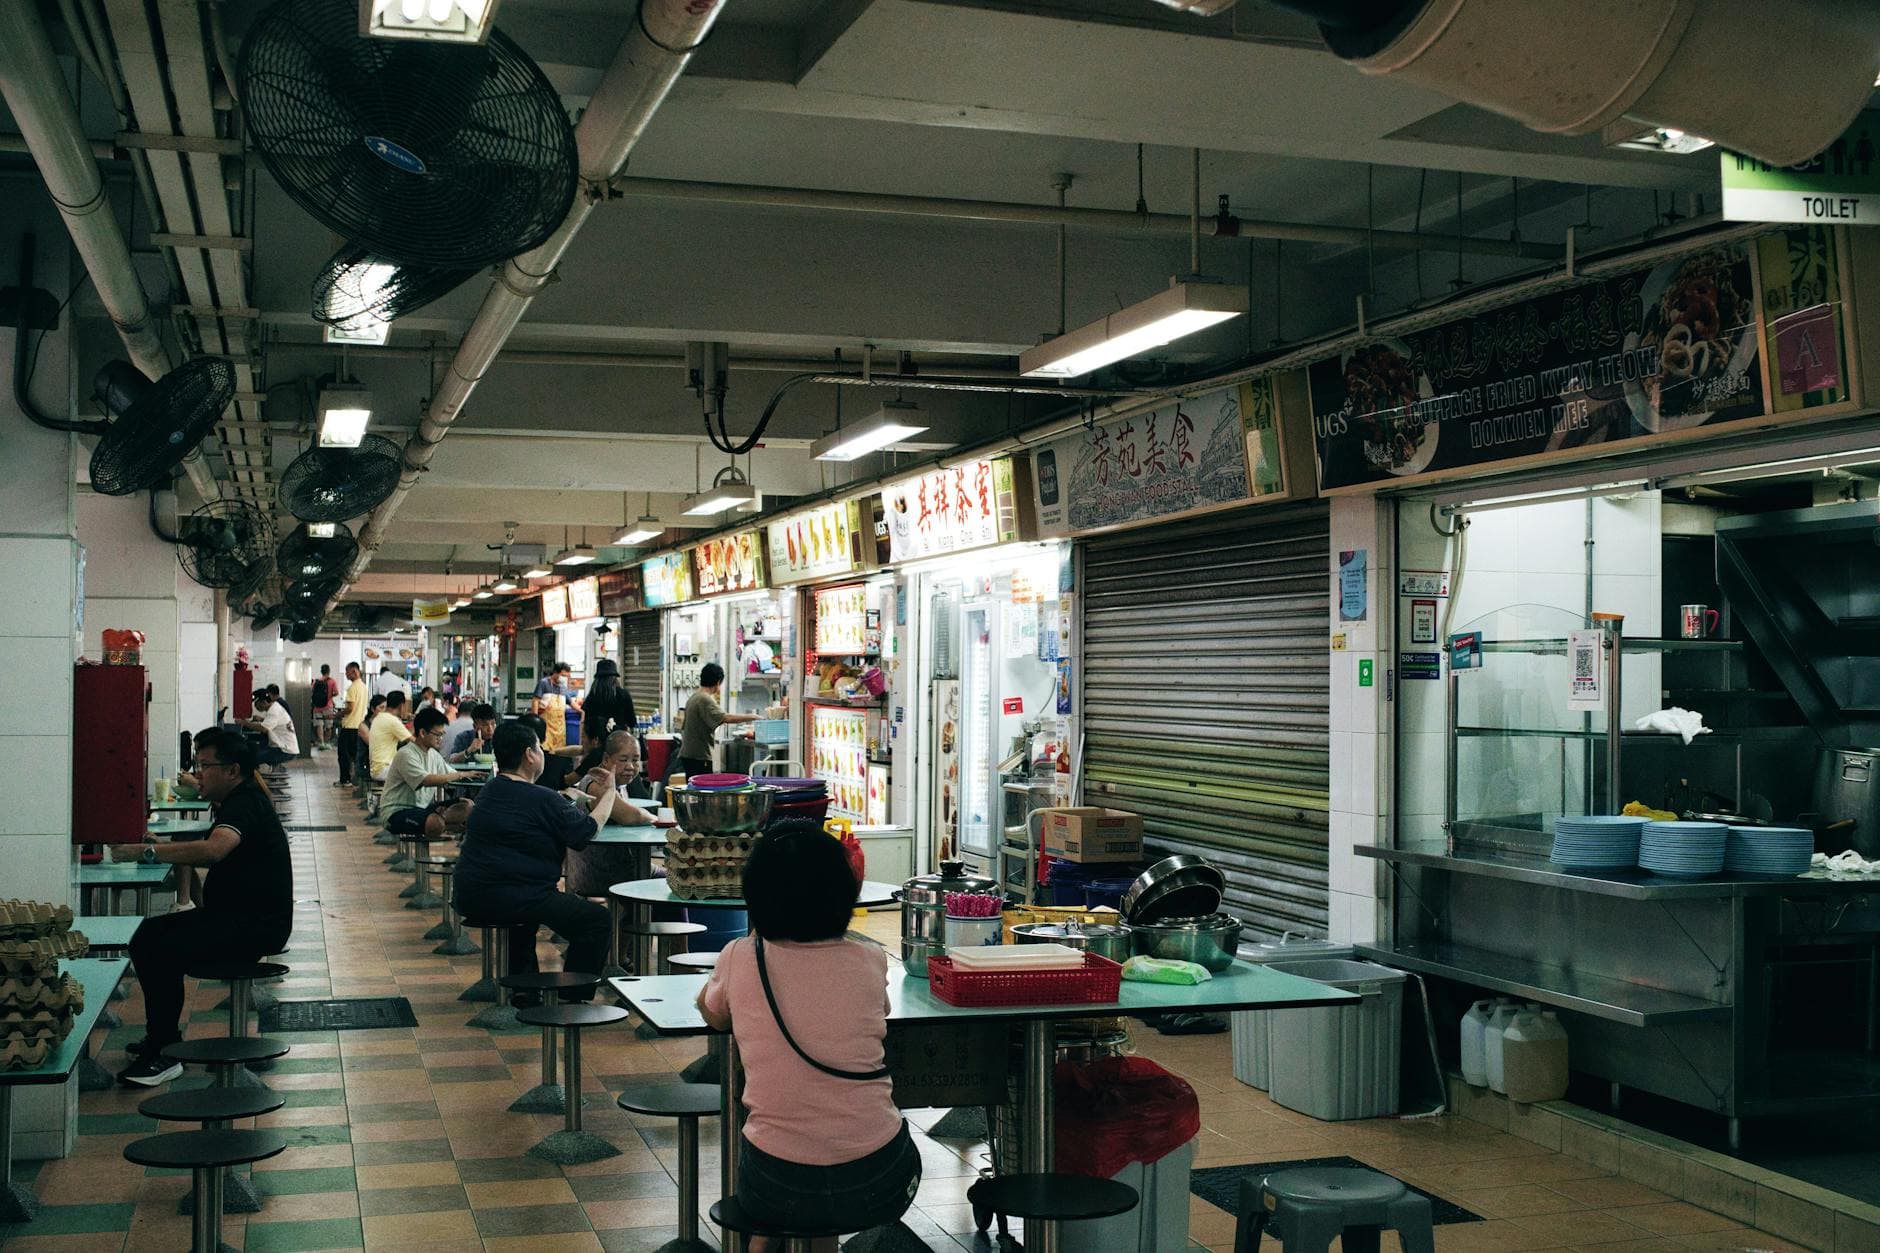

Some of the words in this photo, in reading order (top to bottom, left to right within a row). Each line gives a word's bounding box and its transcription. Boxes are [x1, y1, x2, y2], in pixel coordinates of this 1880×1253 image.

[1803, 197, 1860, 218] TOILET
[1794, 329, 1823, 371] A
[1409, 385, 1482, 430] CUPPAGE
[1486, 371, 1536, 413] FRIED
[1541, 360, 1593, 399] KWAY
[1600, 345, 1660, 385] TEOW
[1092, 402, 1195, 488] 芳苑美食
[1469, 405, 1547, 449] HOKKIEN
[1553, 398, 1591, 434] MEE
[917, 461, 990, 534] 其祥茶室
[1144, 482, 1169, 499] FOOD
[1171, 478, 1201, 496] STALL
